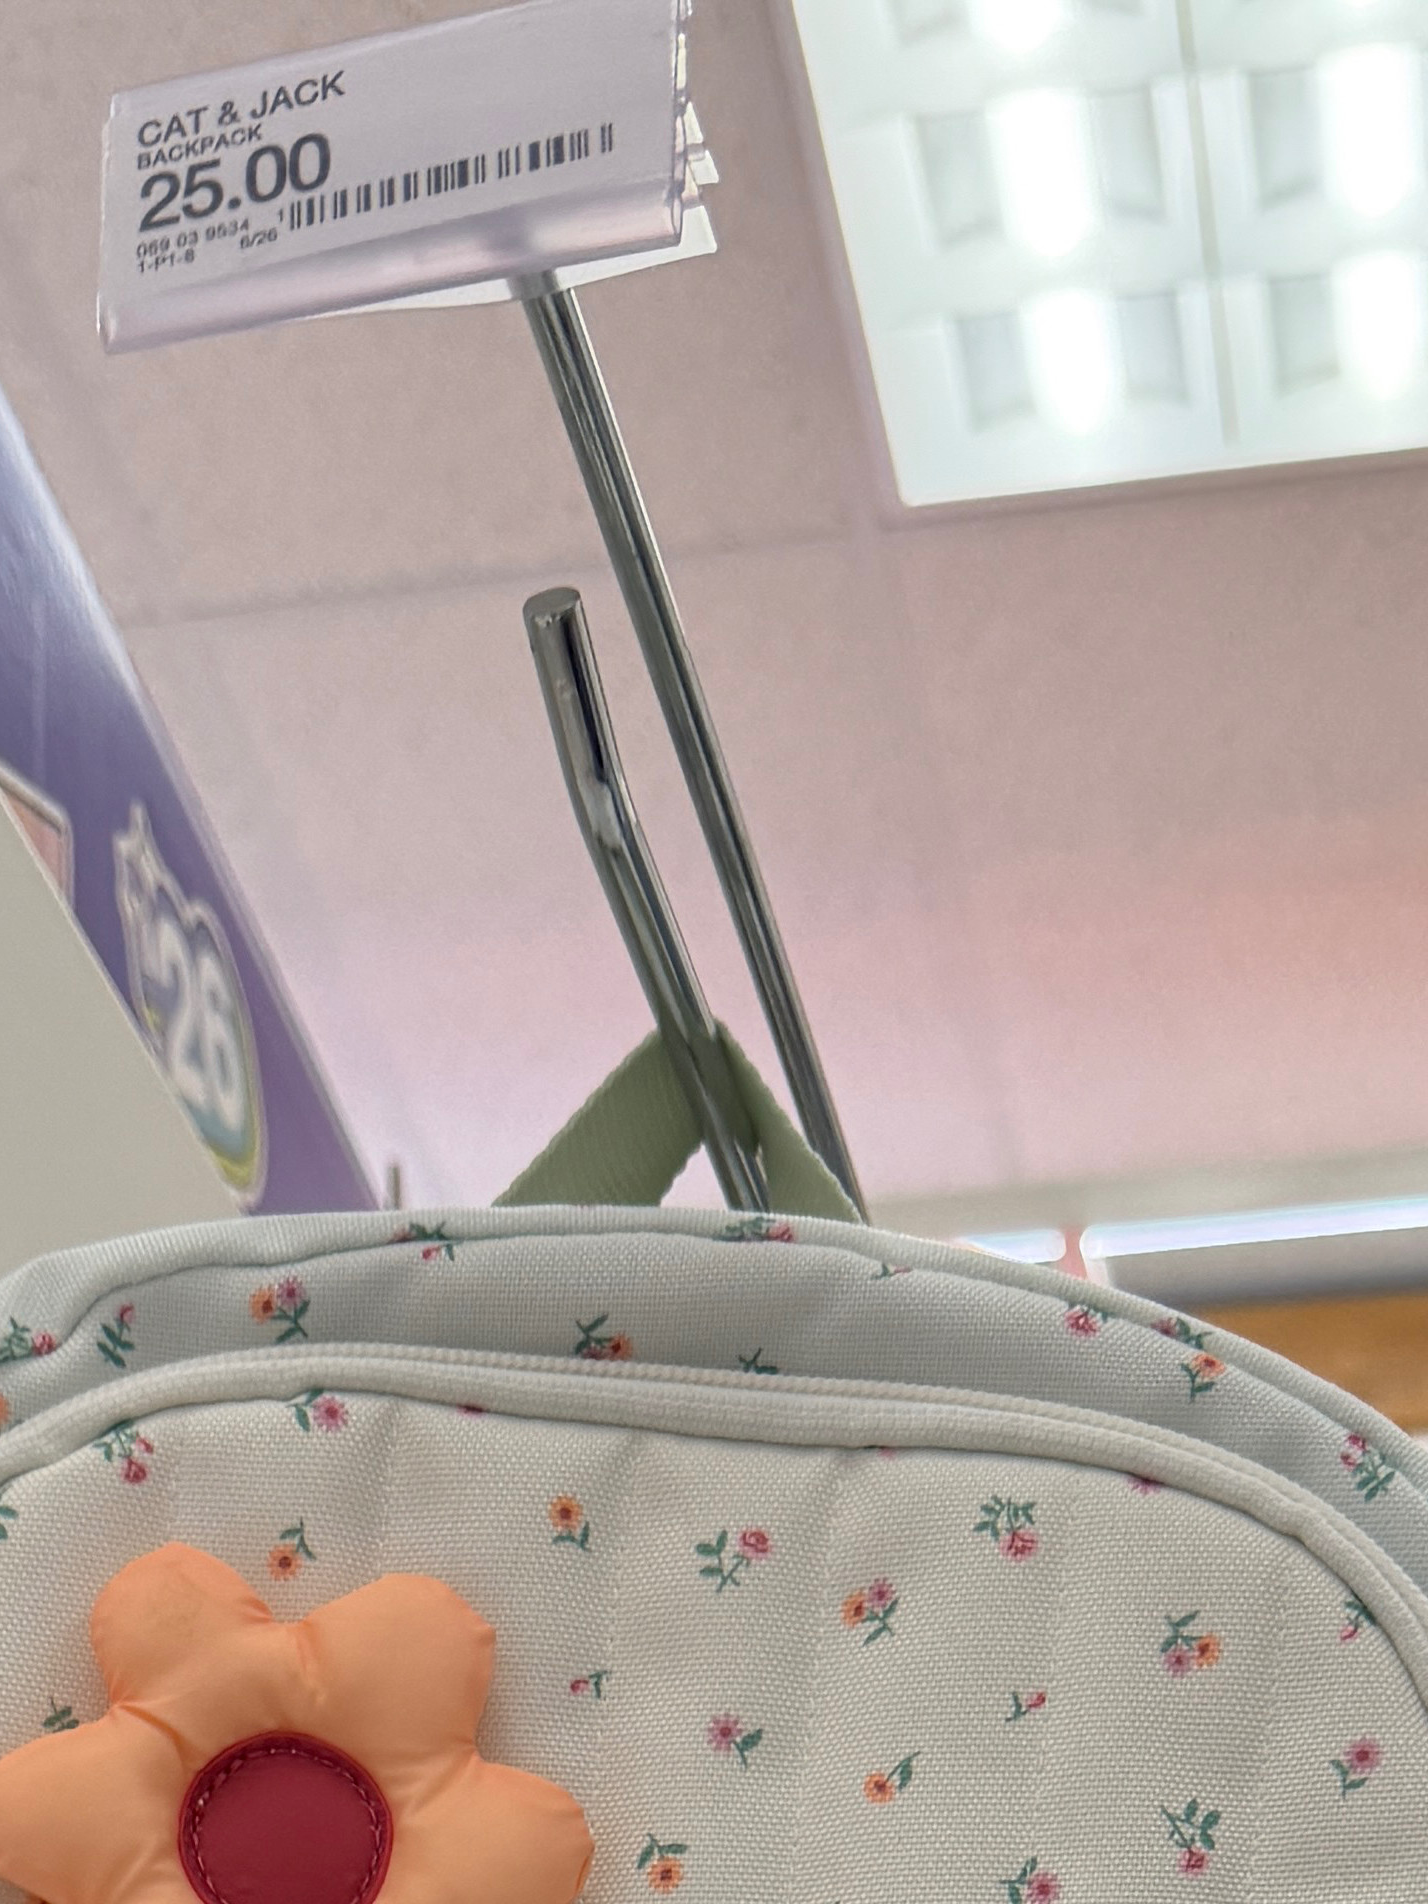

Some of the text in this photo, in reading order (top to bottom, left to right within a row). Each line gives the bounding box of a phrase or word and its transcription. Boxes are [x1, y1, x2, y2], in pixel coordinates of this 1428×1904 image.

[137, 123, 263, 170] BACKPACK
[138, 70, 345, 147] CAT & JACK
[139, 133, 331, 232] 25.00
